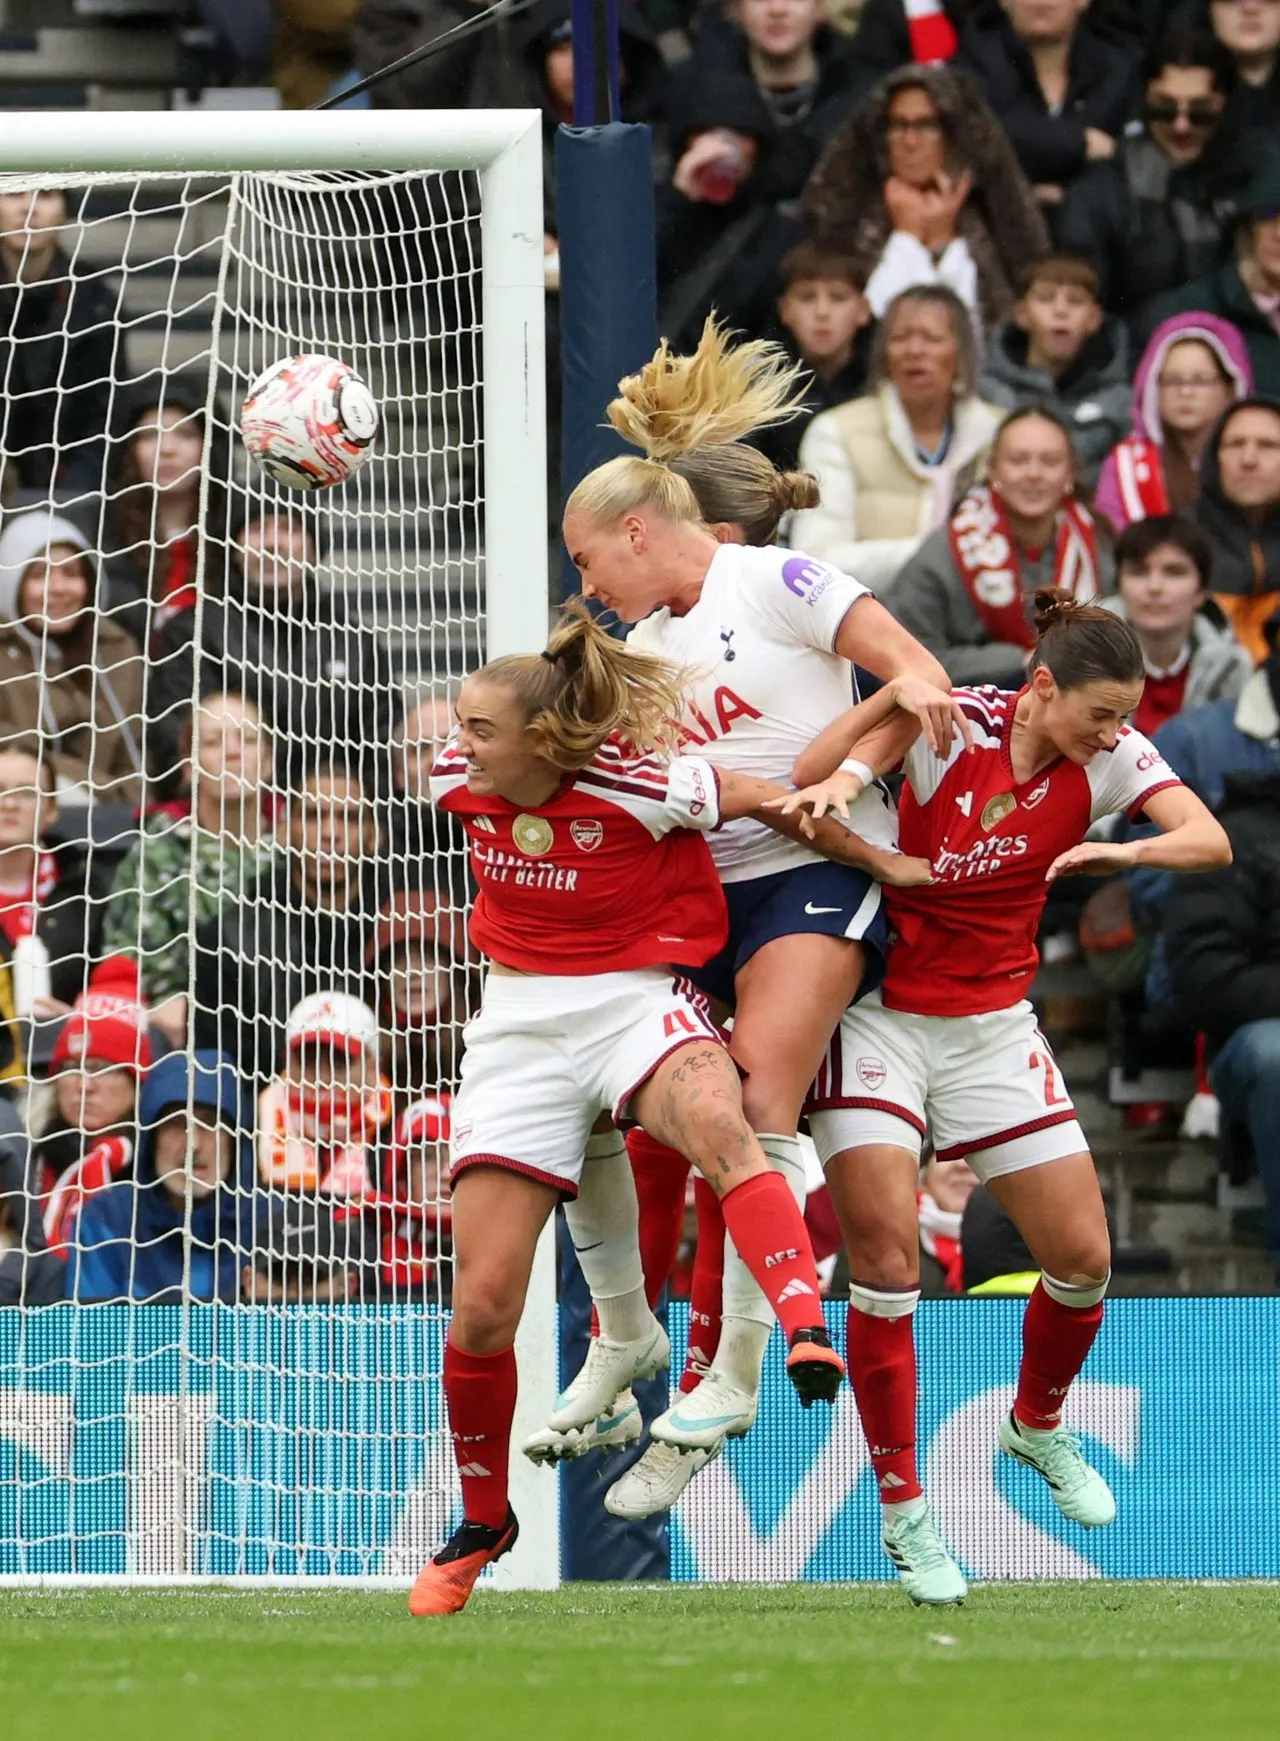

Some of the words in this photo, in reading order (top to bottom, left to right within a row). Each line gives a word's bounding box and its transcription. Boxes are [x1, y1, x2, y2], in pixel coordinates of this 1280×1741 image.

[1136, 751, 1162, 771] de
[662, 1008, 698, 1038] 4
[1029, 1052, 1068, 1107] 2
[764, 1247, 797, 1268] AFC
[1047, 1385, 1069, 1396] AF
